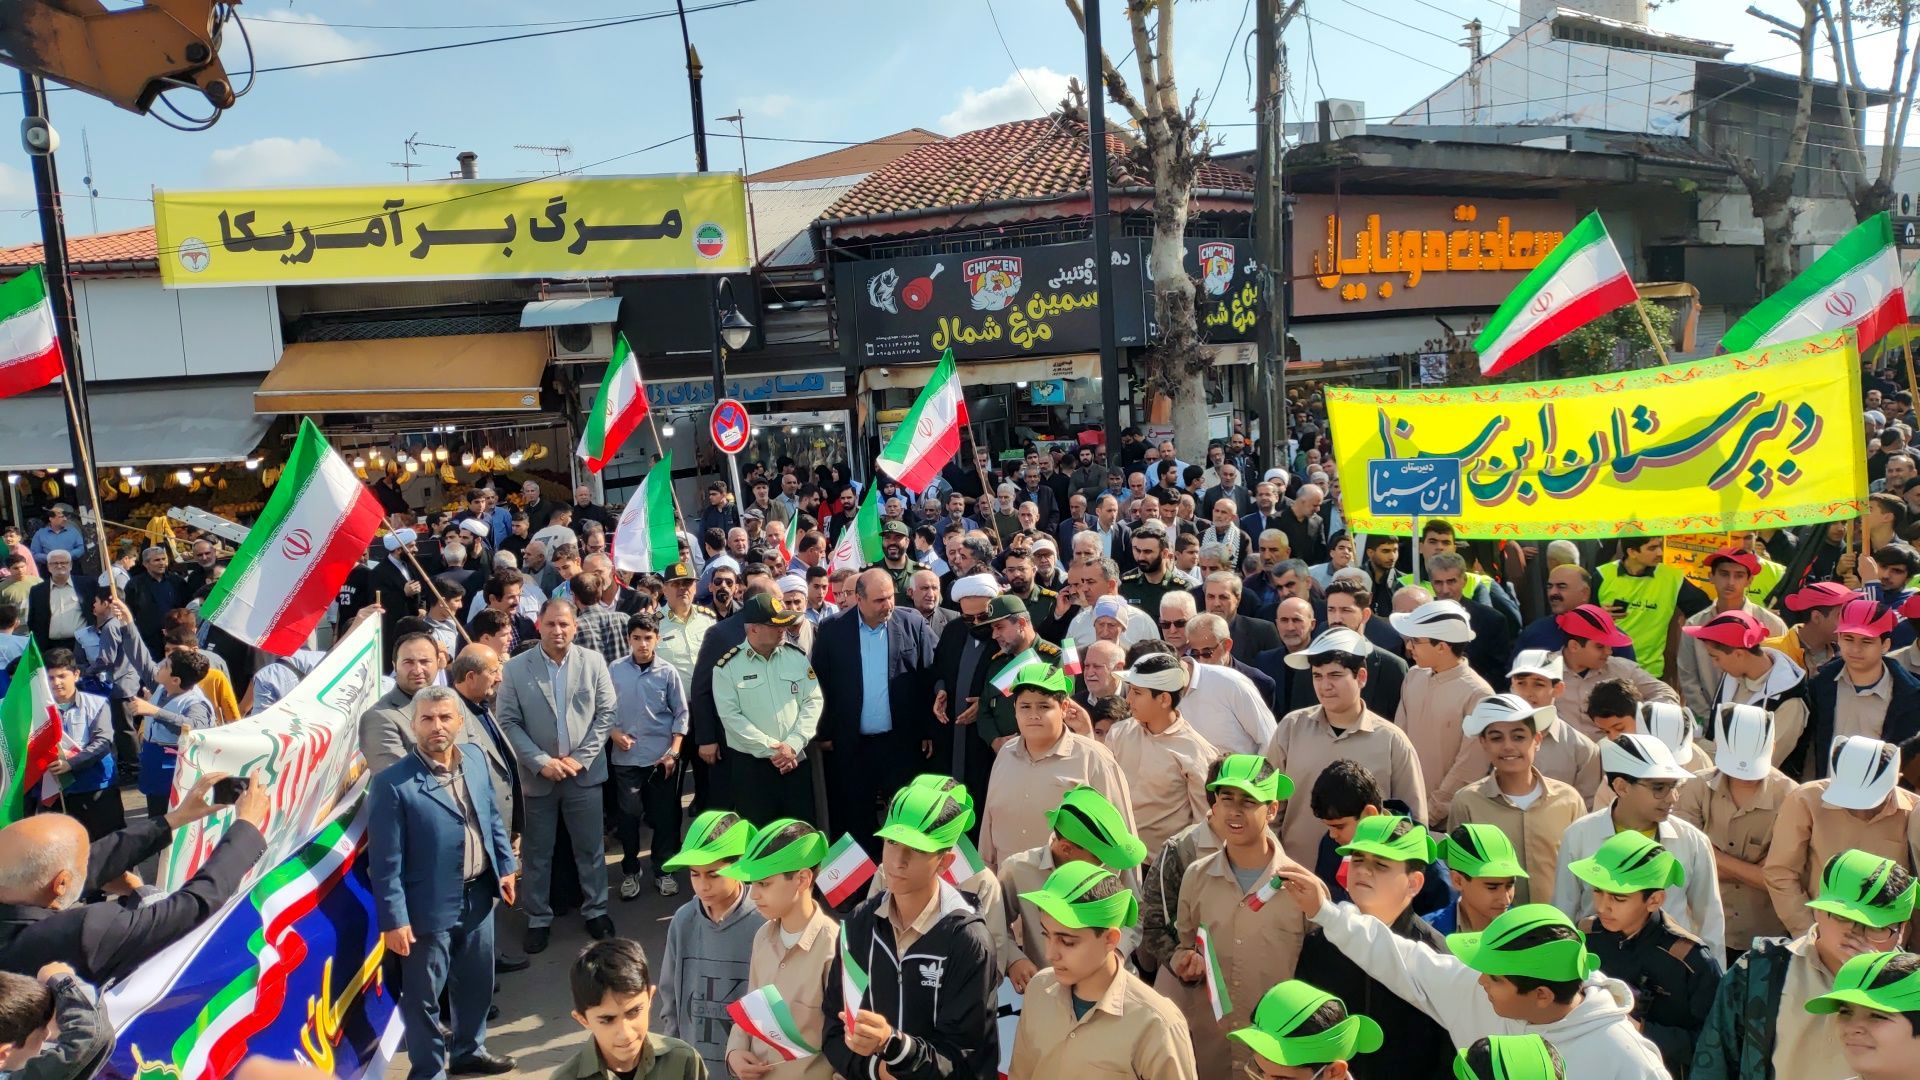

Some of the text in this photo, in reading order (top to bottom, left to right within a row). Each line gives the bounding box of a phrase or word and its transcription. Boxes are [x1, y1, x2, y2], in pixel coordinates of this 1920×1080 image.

[217, 198, 405, 264] آمریکا
[409, 211, 517, 260] بر
[529, 195, 683, 255] مرگ
[1313, 213, 1447, 301] موبایل
[932, 305, 1052, 351] مرغ شمال
[1206, 292, 1256, 334] مرغ شم
[1377, 391, 1824, 507] دبیرستان ابن سنا
[1400, 461, 1435, 474] دبیرستان
[1373, 468, 1456, 512] ابن سینا
[339, 593, 351, 606] 23
[920, 979, 942, 989] adid
